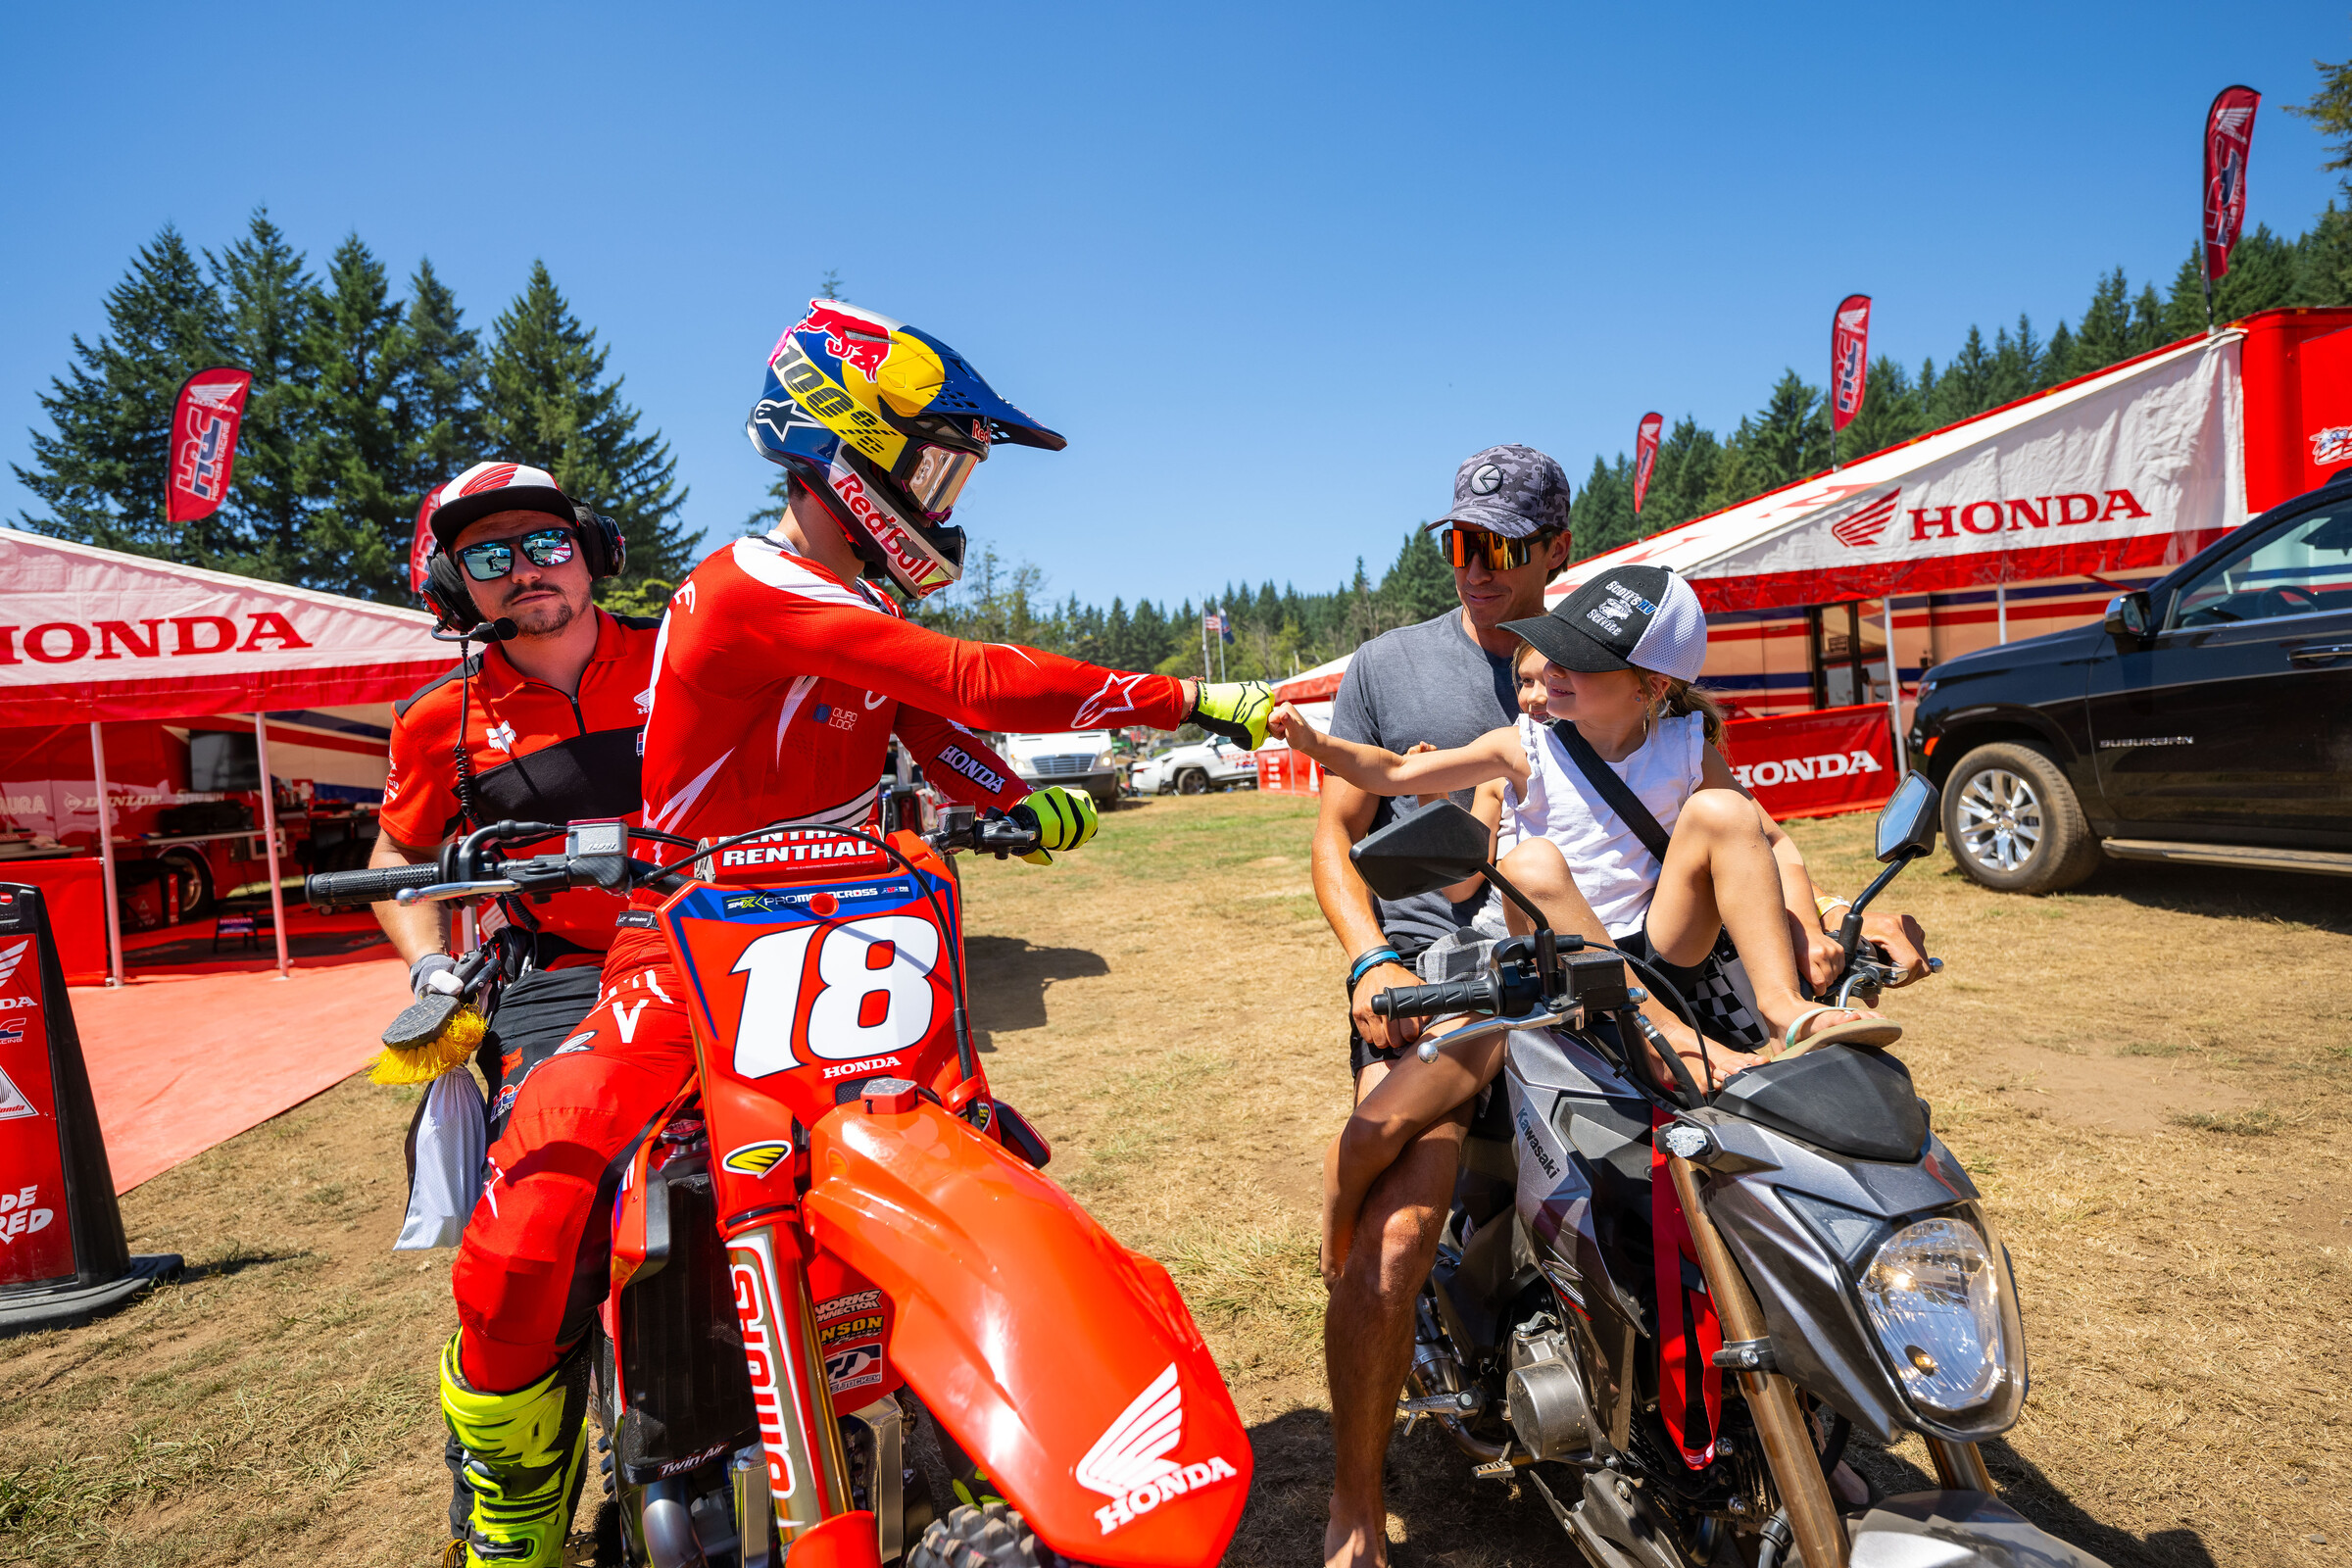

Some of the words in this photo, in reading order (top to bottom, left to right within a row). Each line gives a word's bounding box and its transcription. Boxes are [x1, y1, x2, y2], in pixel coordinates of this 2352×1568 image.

[774, 344, 899, 455] 100%
[1907, 488, 2152, 541] HONDA
[828, 716, 856, 732] LOCK
[832, 707, 858, 722] QUAD
[937, 745, 1007, 795] HONDA
[722, 840, 876, 866] RENTHAL
[727, 914, 941, 1080] 18
[822, 1055, 903, 1079] HONDA
[1515, 1106, 1561, 1180] Kawasaki
[661, 1455, 702, 1476] Twin
[701, 1443, 727, 1462] Air
[1093, 1455, 1238, 1537] HONDA
